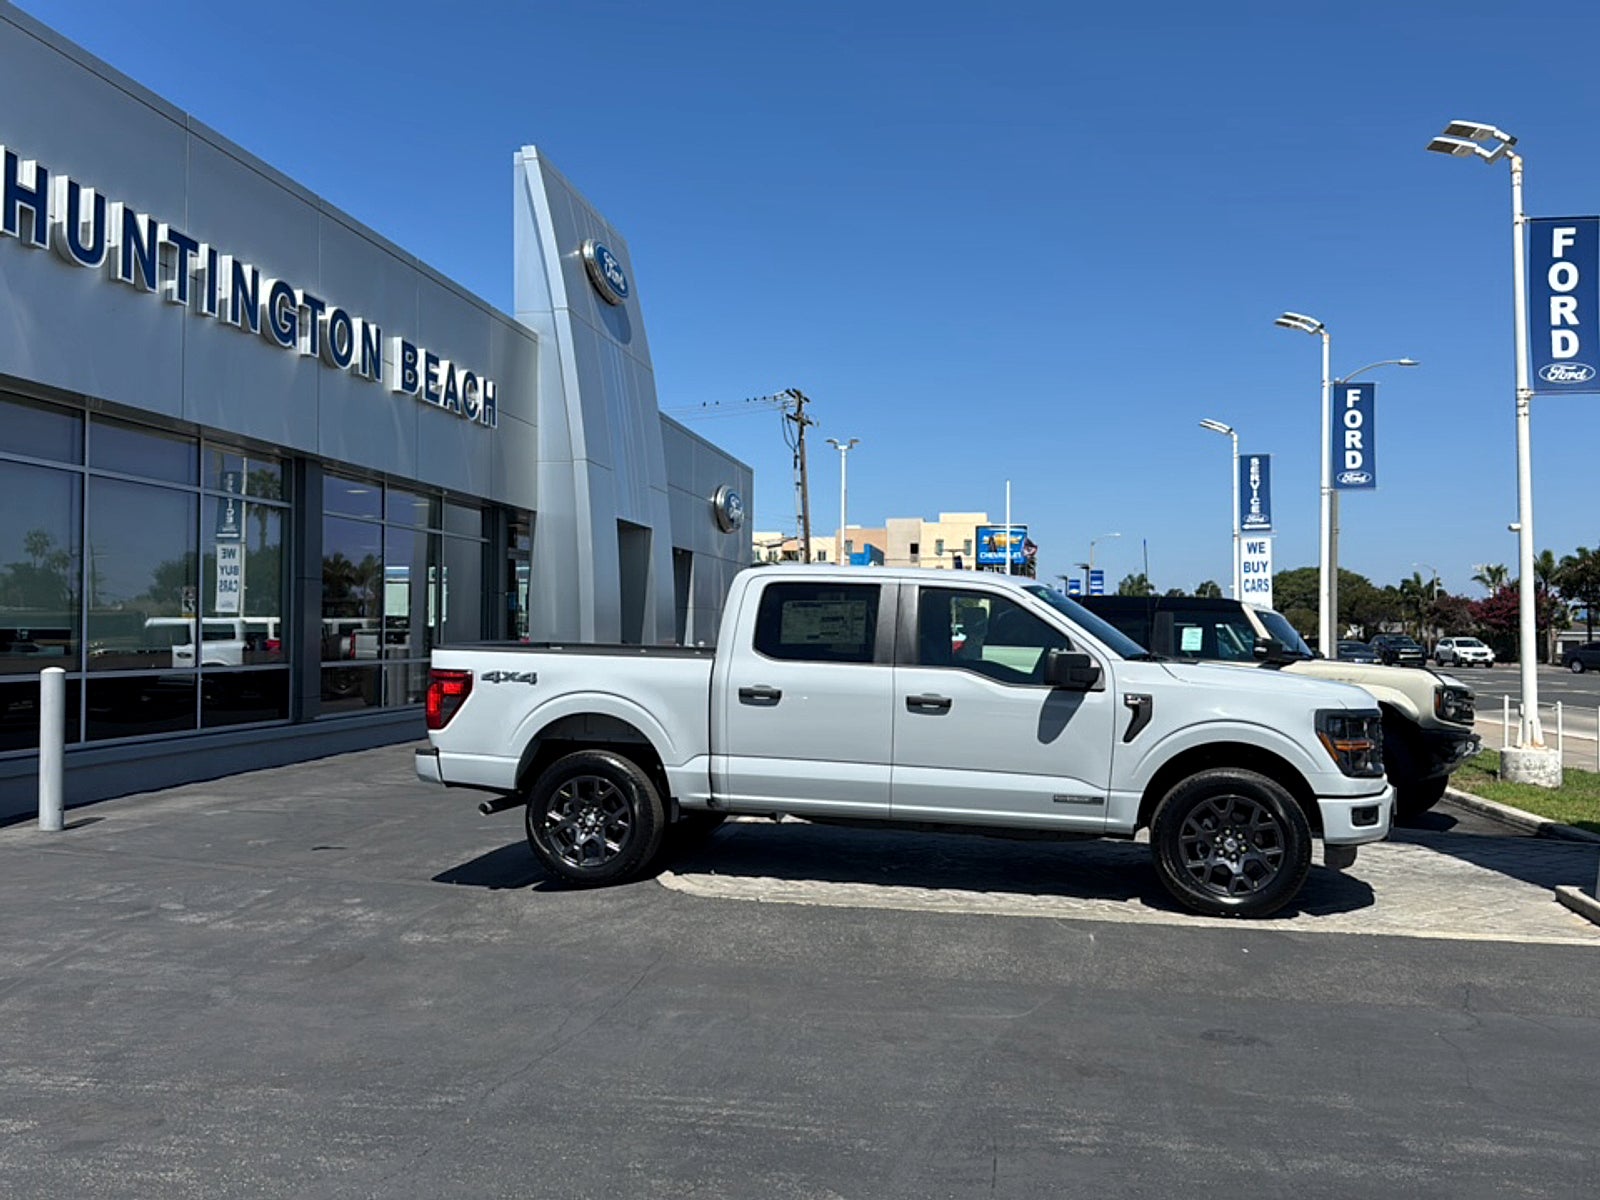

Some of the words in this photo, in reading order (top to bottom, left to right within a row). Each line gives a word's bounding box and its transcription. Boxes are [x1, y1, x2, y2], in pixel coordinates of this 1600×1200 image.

[0, 144, 382, 382] HUNTINGTON
[393, 337, 497, 428] BEACH
[1548, 227, 1580, 359] FORD
[1547, 364, 1587, 381] Ford
[1344, 388, 1363, 469] FORD
[1246, 541, 1266, 555] WE
[1243, 561, 1268, 574] BUY
[1244, 578, 1269, 593] CARS
